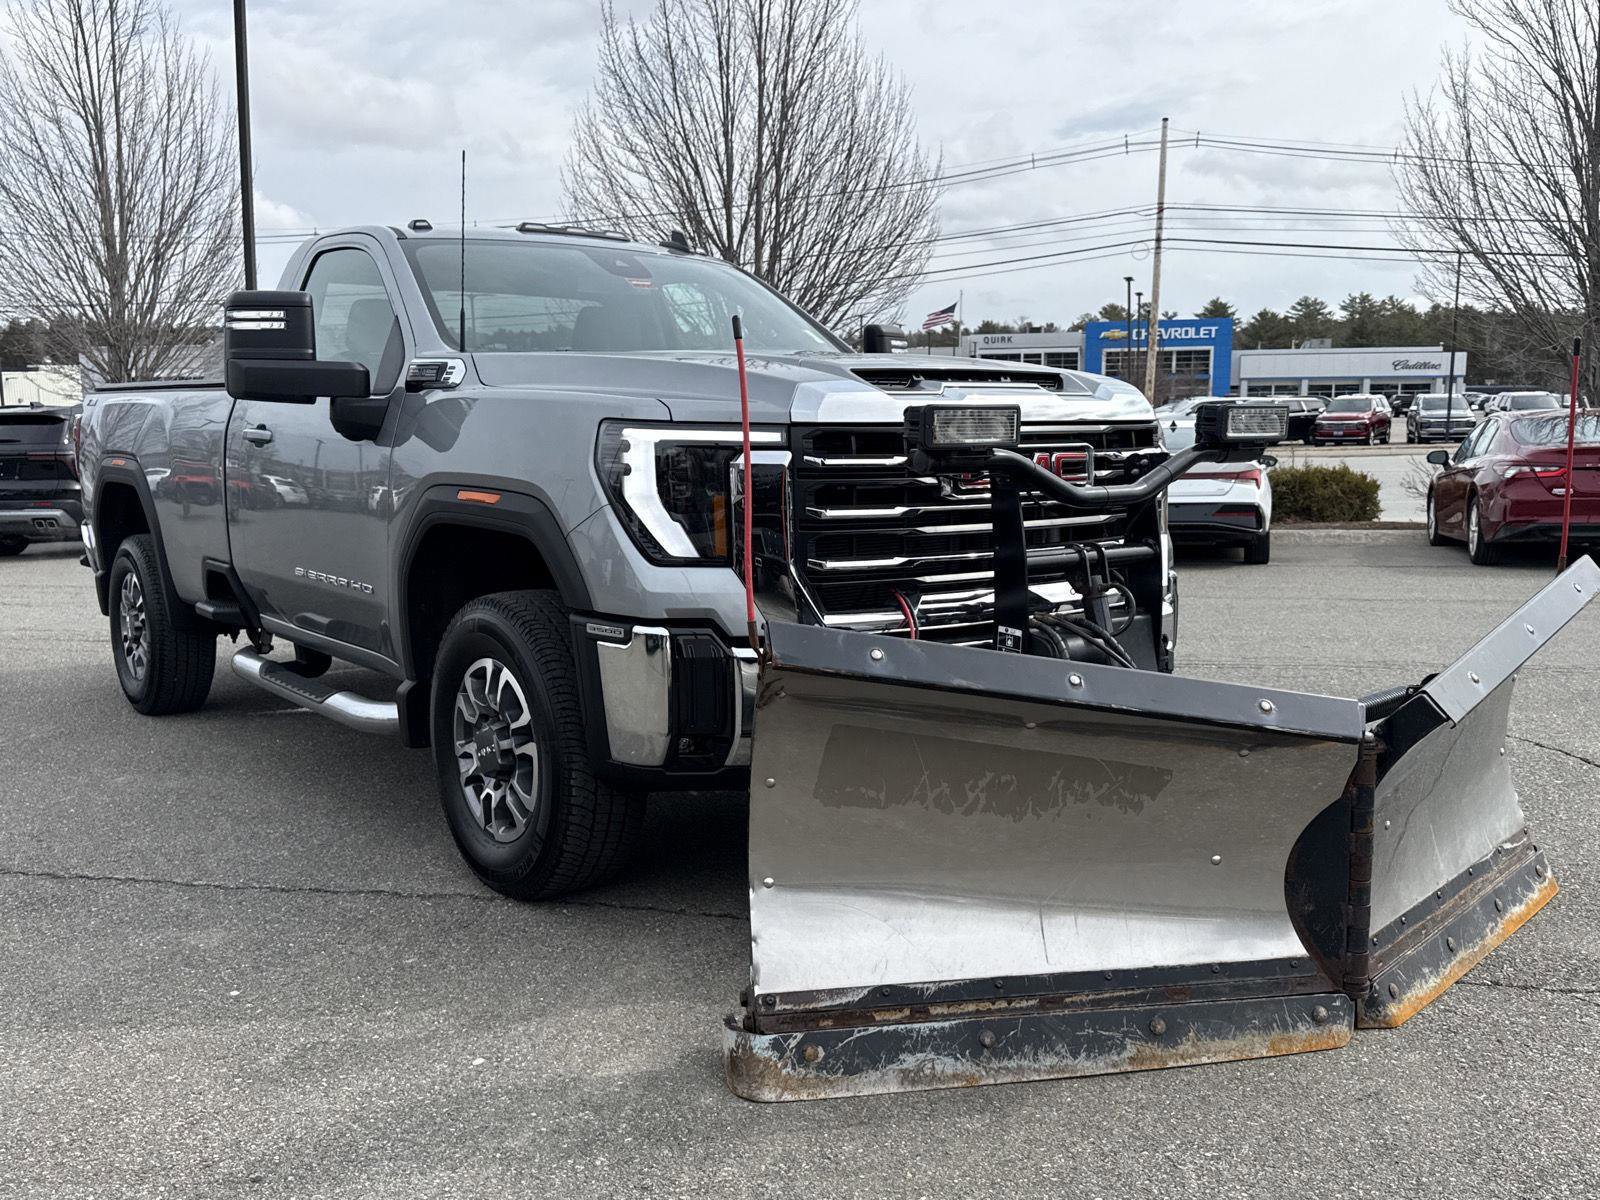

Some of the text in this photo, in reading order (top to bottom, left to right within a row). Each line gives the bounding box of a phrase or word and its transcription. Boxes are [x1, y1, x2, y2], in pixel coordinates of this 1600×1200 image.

[983, 336, 1013, 345] QUIRK
[1392, 359, 1441, 370] Cadillac
[295, 567, 374, 594] SIERRA HD
